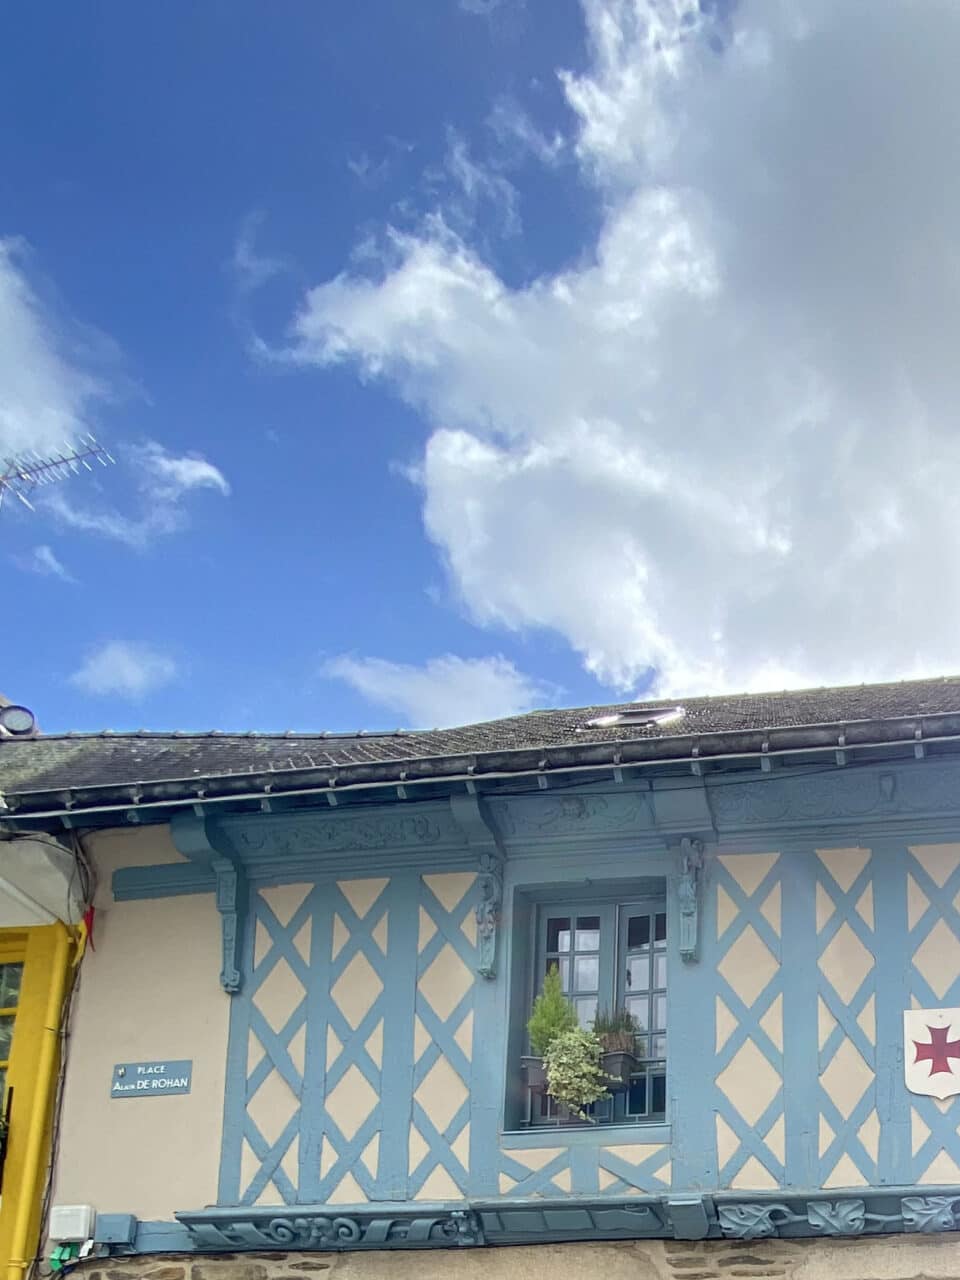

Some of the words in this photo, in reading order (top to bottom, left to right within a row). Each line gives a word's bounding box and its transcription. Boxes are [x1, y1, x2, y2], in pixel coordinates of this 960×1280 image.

[137, 1065, 167, 1075] PLACE
[136, 1079, 150, 1090] DE
[151, 1077, 189, 1089] ROHAN
